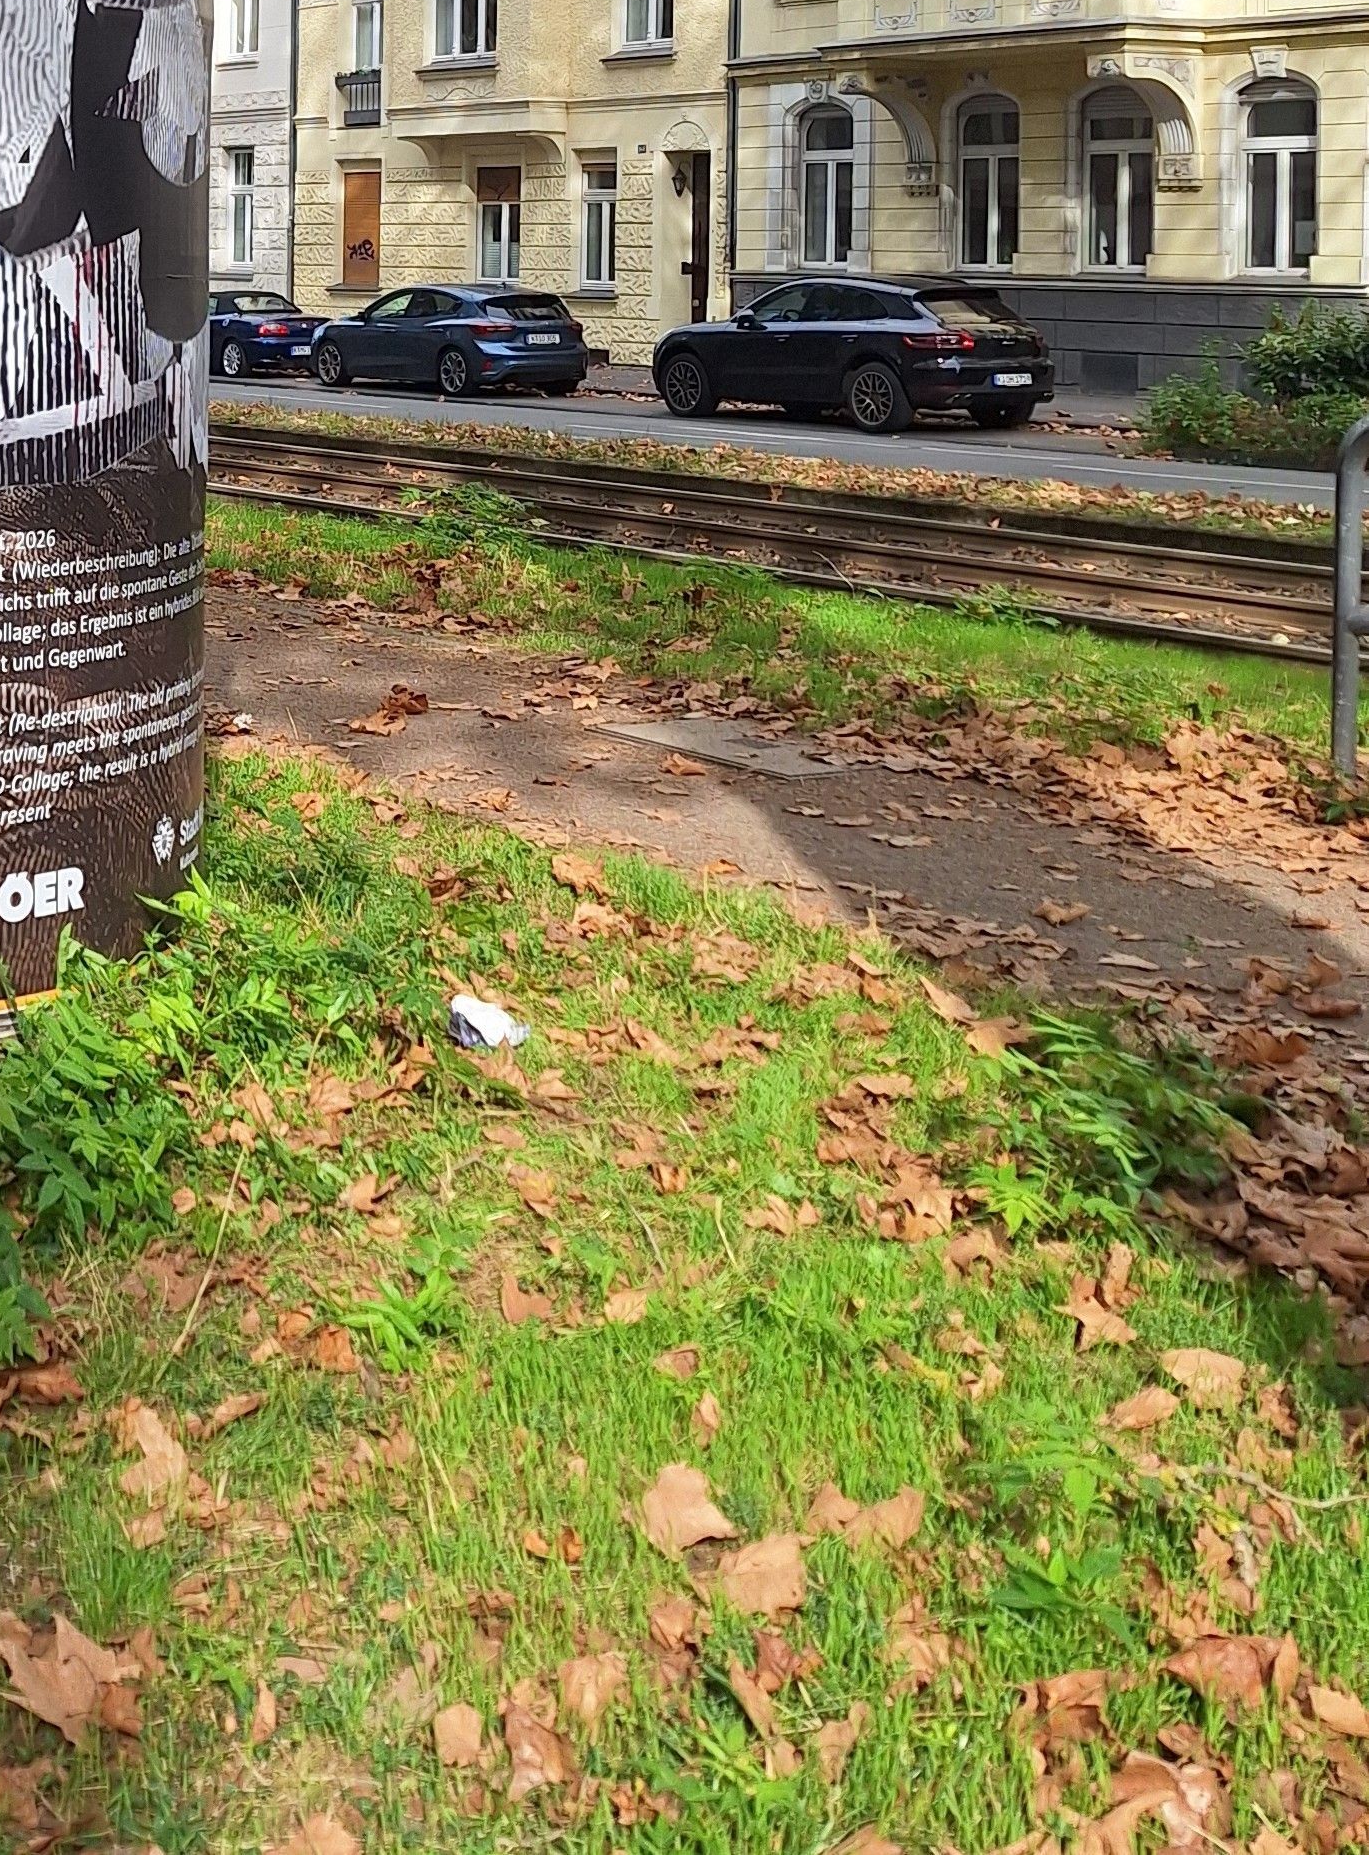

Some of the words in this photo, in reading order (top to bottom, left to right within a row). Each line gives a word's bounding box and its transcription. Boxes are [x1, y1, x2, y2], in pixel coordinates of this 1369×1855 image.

[13, 544, 161, 584] (Wiederbeschreibung):
[163, 543, 177, 559] Die
[178, 537, 191, 555] alte
[15, 529, 56, 550] 2026
[37, 586, 71, 608] trifft
[74, 583, 98, 604] auf
[100, 581, 120, 601] die
[122, 575, 168, 600] spontane
[169, 569, 188, 587] Geste
[51, 617, 77, 637] das
[81, 610, 133, 635] Ergebnis
[135, 606, 148, 625] ist
[149, 602, 164, 621] ein
[165, 592, 193, 619] hybrides
[12, 649, 44, 672] und
[48, 640, 127, 668] Gegenwart.
[9, 697, 126, 736] (Re-description):
[129, 693, 151, 712] The
[150, 684, 165, 707] old
[52, 735, 96, 757] meets
[100, 728, 120, 749] the
[122, 713, 180, 746] spontaneous
[79, 762, 102, 783] the
[105, 751, 137, 778] result
[139, 750, 149, 768] is
[150, 753, 157, 764] a
[158, 736, 183, 764] hybrid
